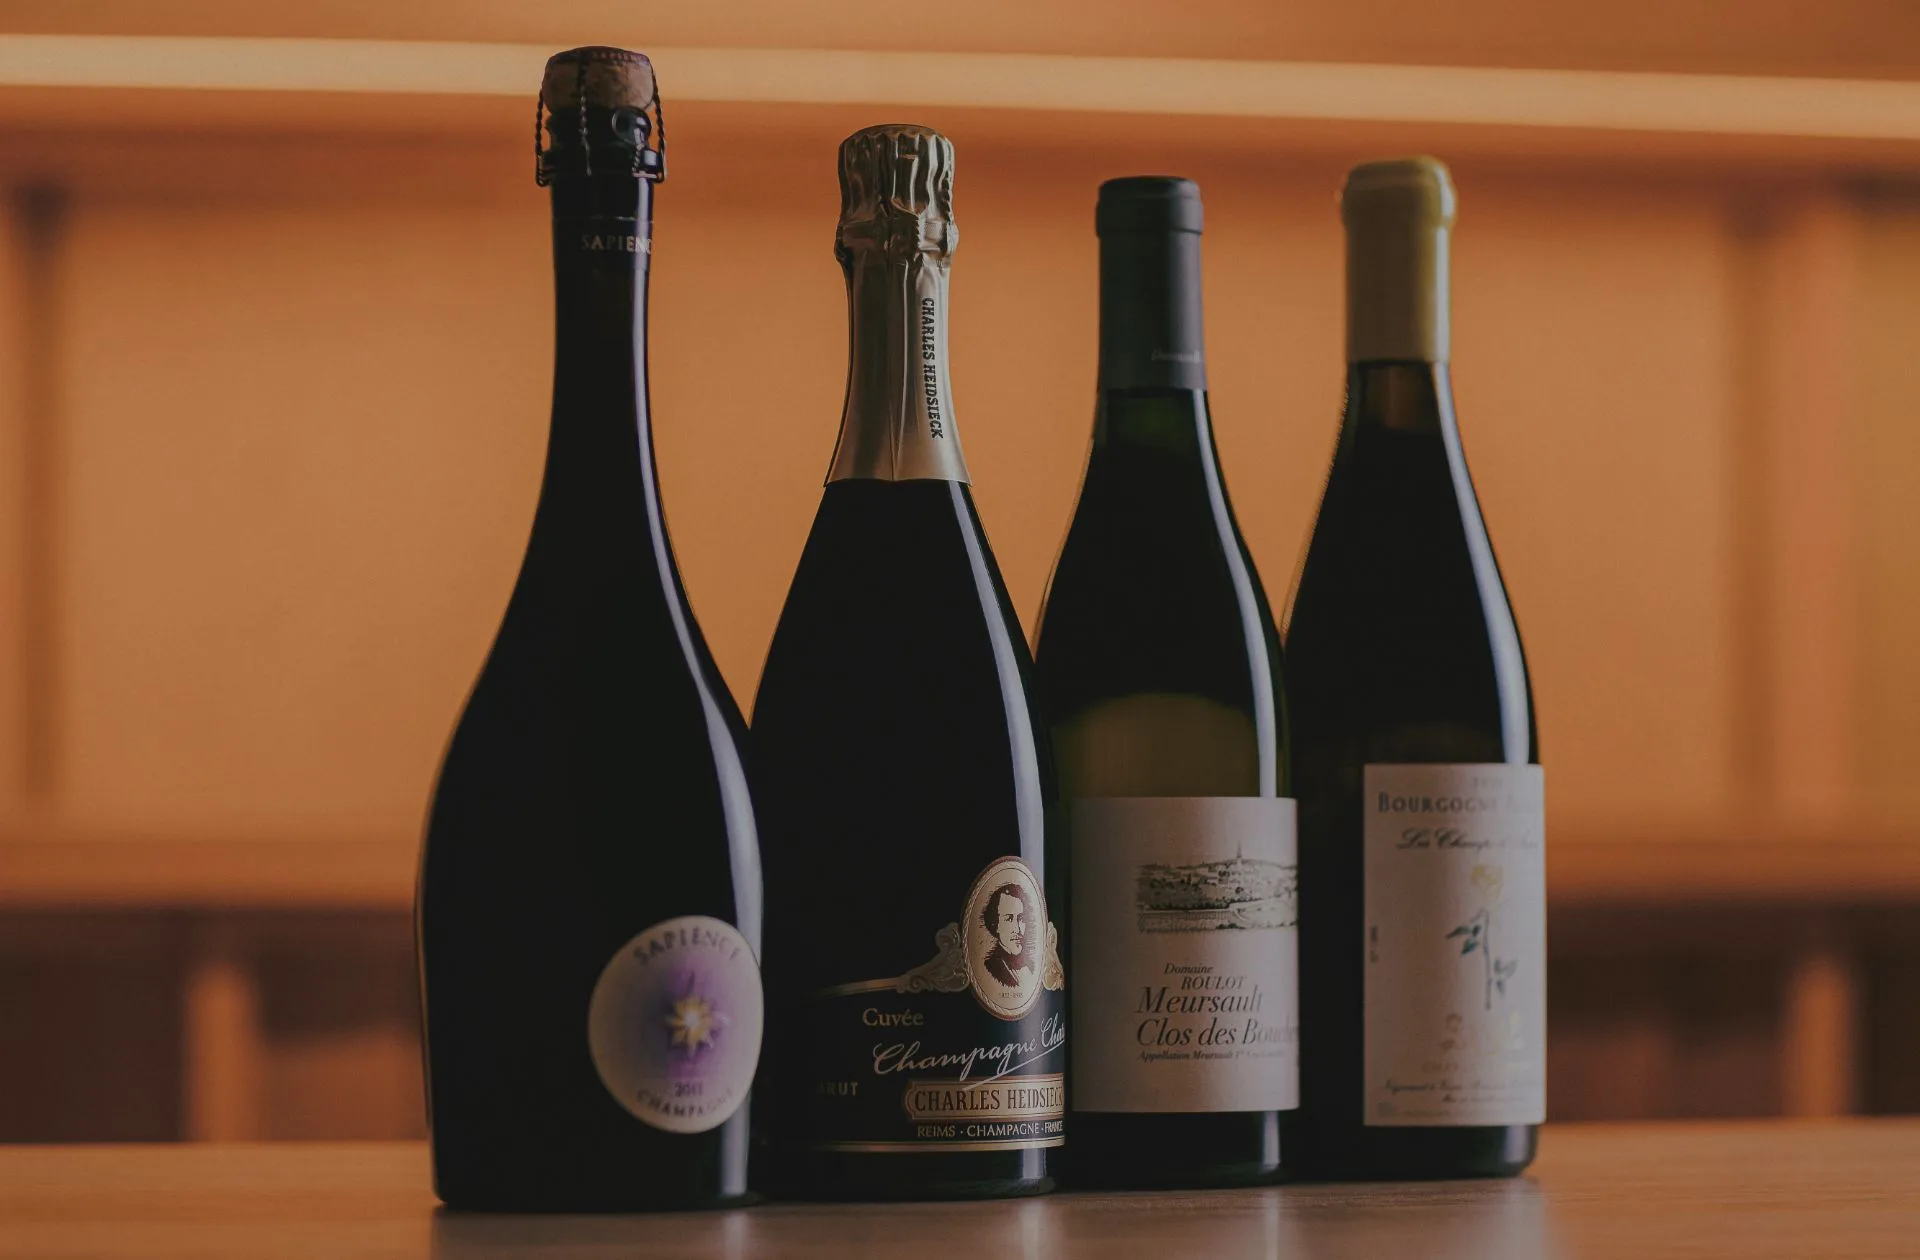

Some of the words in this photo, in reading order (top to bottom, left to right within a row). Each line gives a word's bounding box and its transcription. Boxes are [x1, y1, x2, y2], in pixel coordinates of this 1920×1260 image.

[922, 297, 935, 361] CHARLES
[923, 364, 944, 439] HEIDSIECK
[1163, 962, 1214, 974] Domaine
[1180, 975, 1247, 990] ROULOT
[1134, 984, 1263, 1013] Meursault
[862, 1008, 924, 1027] Cuvée
[1136, 1017, 1192, 1046] Clos
[1197, 1017, 1237, 1045] des
[873, 1037, 1038, 1082] Champagne
[816, 1081, 858, 1097] BRUT
[914, 1089, 1001, 1111] CHARLES
[917, 1126, 956, 1138] REIMS
[966, 1122, 1040, 1137] CHAMPAGNE
